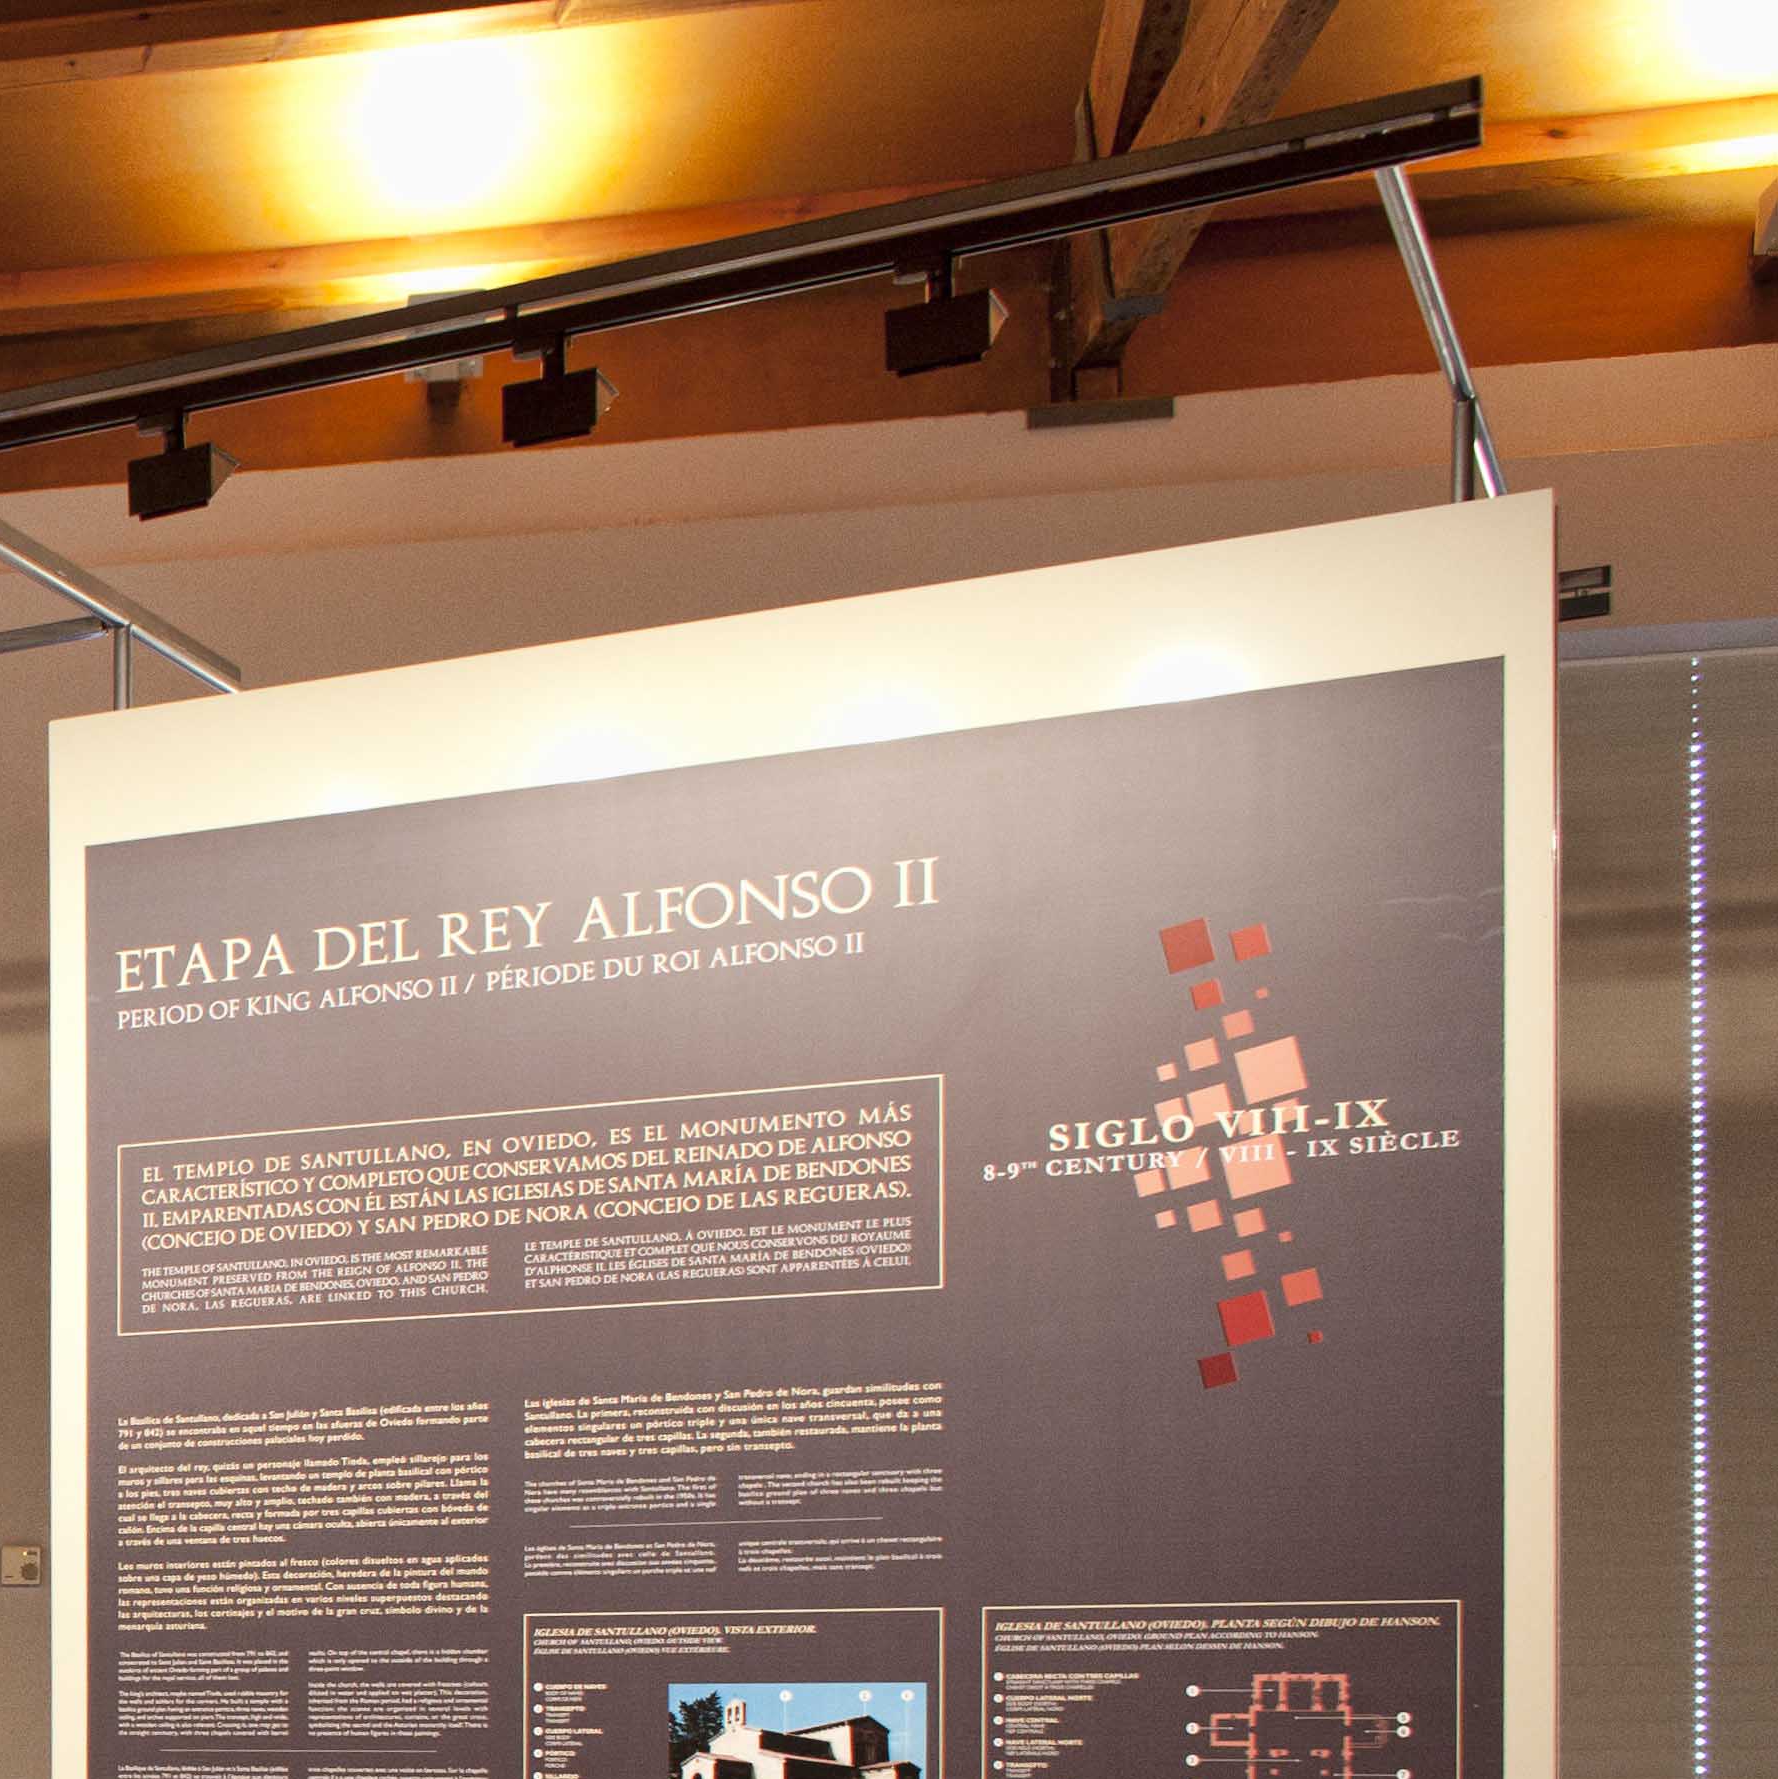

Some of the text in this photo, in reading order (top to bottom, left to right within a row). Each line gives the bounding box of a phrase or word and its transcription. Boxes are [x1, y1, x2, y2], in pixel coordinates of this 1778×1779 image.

[116, 856, 938, 993] ETAPA DEL REY ALFONSO II
[119, 1003, 203, 1030] PERIOD
[209, 999, 239, 1019] OF
[247, 991, 310, 1016] KING
[320, 979, 432, 1008] ALFONSO
[441, 976, 456, 996] II
[487, 961, 595, 991] PÉRIODE
[603, 955, 643, 979] DU
[652, 950, 699, 974] ROI
[709, 935, 837, 968] ALFONSO
[845, 932, 863, 954] II
[143, 1103, 911, 1182] EL TEMPLO DE SANTULLANO, EN OVIEDO, ES EL MONUMENTO MÁS
[1046, 1149, 1181, 1176] CENTURY
[1219, 1143, 1275, 1164] VIII
[1307, 1138, 1339, 1157] IX
[1349, 1130, 1460, 1154] SIÈCLE
[1049, 1098, 1388, 1152] SIGLO VIII-IX
[142, 1130, 911, 1205] CARACTERÍSTICO Y COMPLETO QUE CONSERVAMOS DEL REINADO DE ALFONSO
[163, 1200, 313, 1226] EMPARENTADAS
[316, 1197, 359, 1215] CON
[365, 1192, 386, 1211] ÉL
[390, 1188, 449, 1209] ESTÁN
[455, 1187, 487, 1205] LAS
[493, 1180, 574, 1202] IGLESIAS
[579, 1178, 605, 1196] DE
[608, 1173, 677, 1193] SANTA
[683, 1165, 757, 1187] MARÍA
[763, 1164, 790, 1182] DE
[796, 1155, 911, 1180] BENDONES
[142, 1181, 911, 1251] (CONCEJO DE OVIEDO) Y SAN PEDRO DE NORA (CONCEJO DE LAS REGUERAS).
